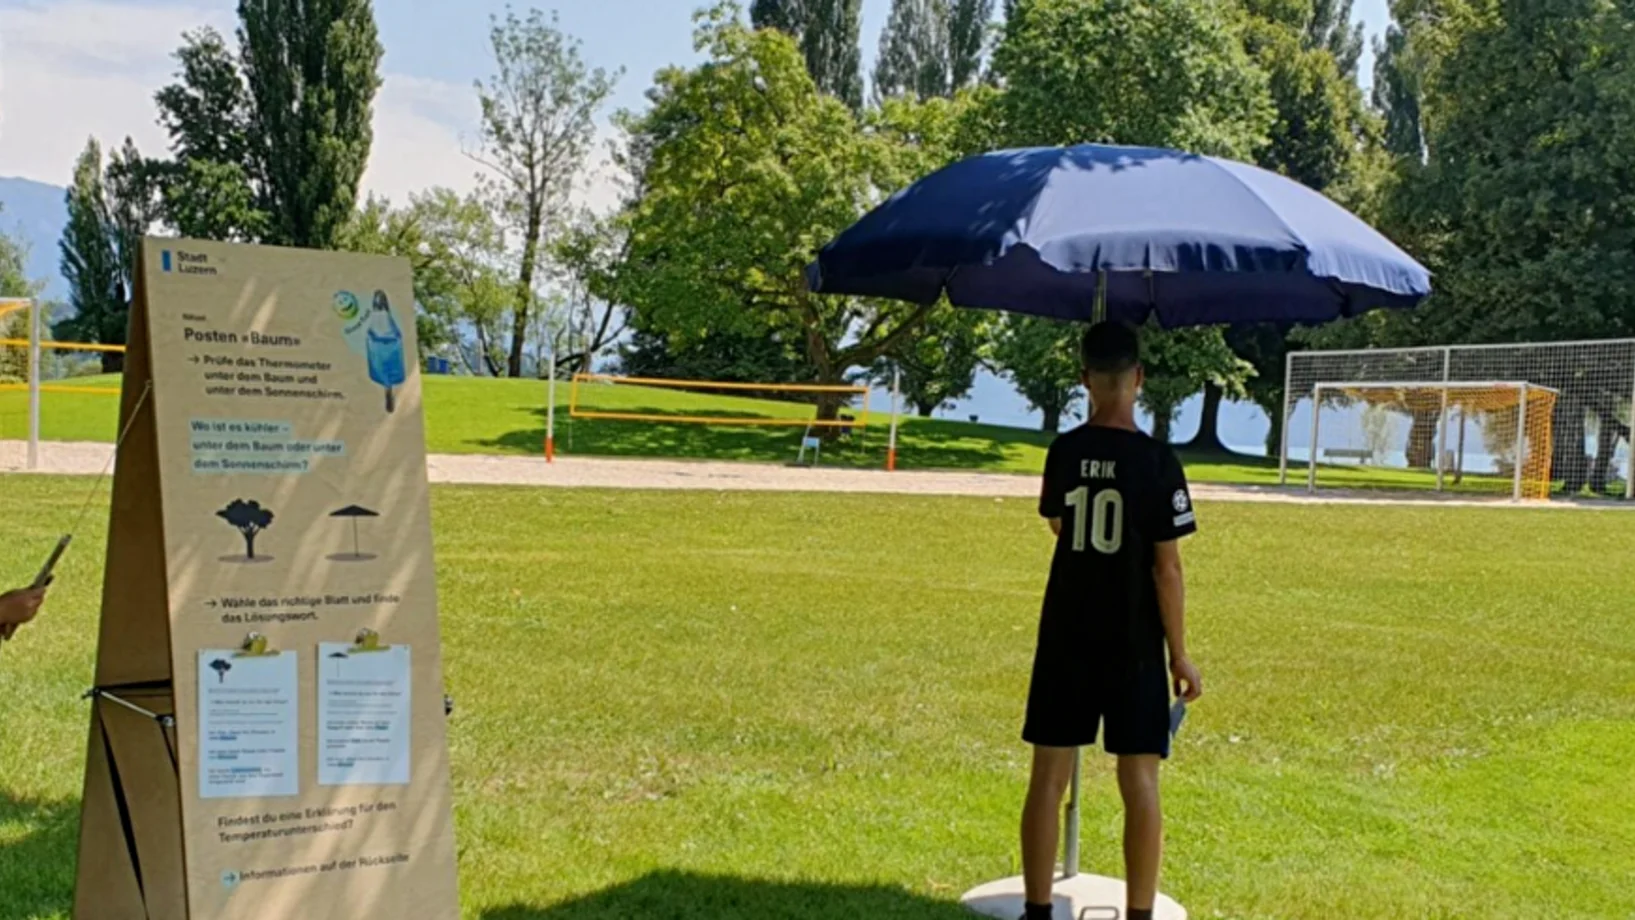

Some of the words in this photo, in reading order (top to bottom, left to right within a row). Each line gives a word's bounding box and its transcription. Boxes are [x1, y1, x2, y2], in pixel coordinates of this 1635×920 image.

[178, 263, 217, 276] Luzern
[184, 327, 238, 344] Posten
[203, 354, 234, 367] Prüfe
[236, 357, 256, 368] das
[259, 358, 331, 371] Thermometer
[204, 372, 235, 382] unter
[236, 371, 262, 383] dem
[264, 372, 295, 384] Baum
[297, 375, 318, 385] und
[205, 386, 236, 396] unter
[237, 386, 263, 397] dem
[265, 387, 345, 400] Sonnenschirm.
[191, 421, 210, 432] Wo
[212, 422, 226, 432] ist
[244, 423, 279, 434] kühler
[192, 440, 223, 451] unter
[225, 440, 250, 451] dem
[252, 441, 284, 452] Baum
[286, 442, 311, 452] oder
[313, 443, 342, 452] unter
[194, 458, 220, 469] dem
[1080, 459, 1117, 479] ERIK
[1064, 485, 1124, 554] 10
[221, 598, 256, 609] Wähle
[258, 597, 280, 607] das
[281, 596, 323, 608] richtige
[352, 593, 372, 604] und
[221, 613, 243, 624] das
[244, 610, 319, 624] Lösungswort.
[218, 814, 260, 828] Findest
[262, 812, 278, 824] du
[279, 811, 303, 821] eine
[305, 805, 358, 819] Erklärung
[376, 801, 397, 812] den
[239, 864, 318, 881] Informationen
[319, 858, 338, 872] auf
[339, 857, 357, 869] der
